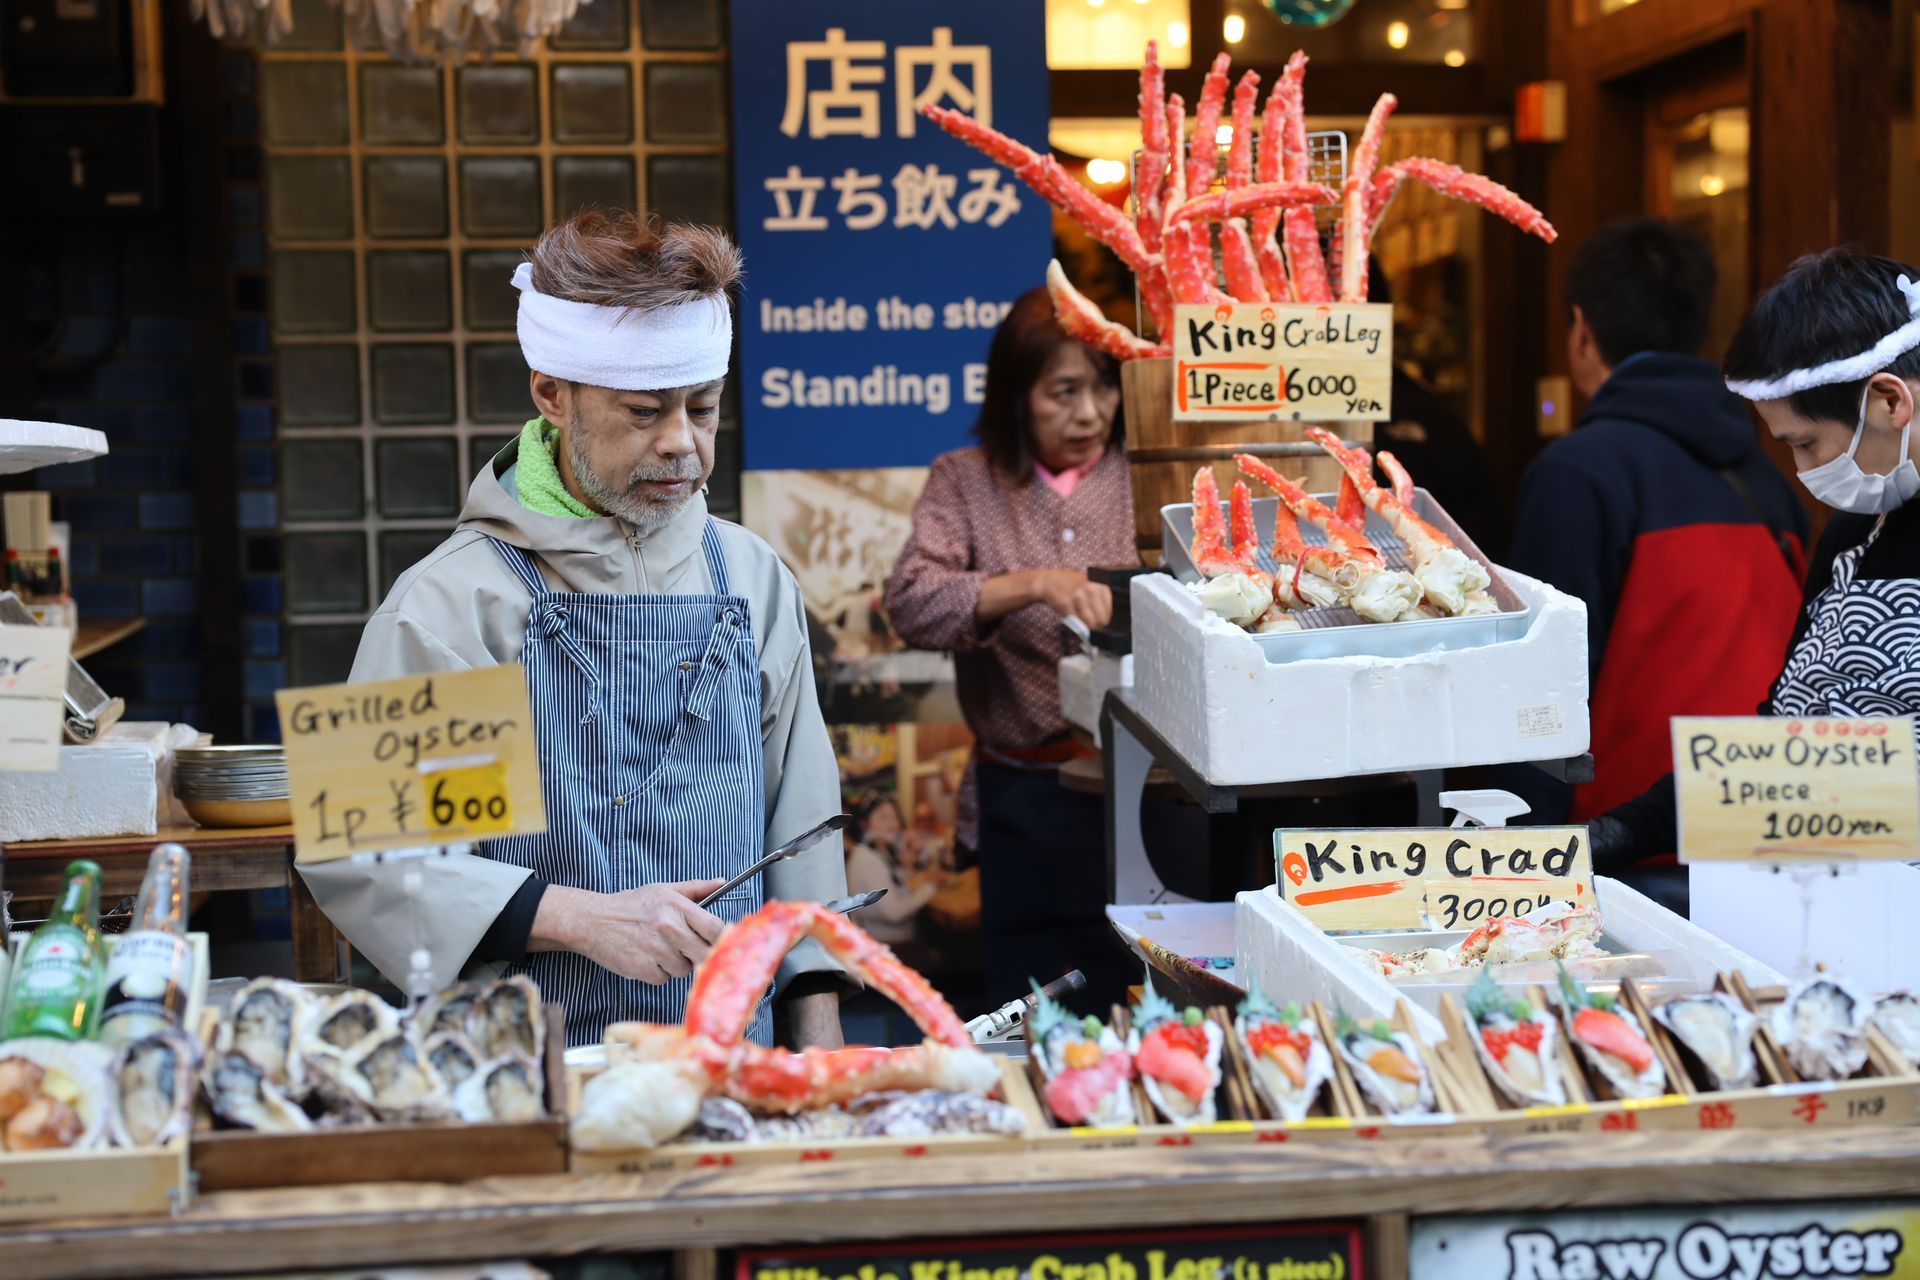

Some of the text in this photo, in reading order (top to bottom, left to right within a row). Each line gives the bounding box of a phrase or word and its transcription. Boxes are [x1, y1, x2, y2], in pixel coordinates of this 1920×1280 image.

[780, 27, 992, 138] 店内
[763, 163, 1021, 230] 立ち飲み
[760, 299, 867, 332] Inside
[876, 297, 935, 330] the
[1188, 317, 1276, 356] King
[761, 363, 950, 414] Standing
[1285, 367, 1357, 402] 6000
[1345, 397, 1383, 414] yen
[290, 678, 437, 734] Grilled
[374, 718, 518, 767] Oyster
[1689, 734, 1902, 771] Raw Oyster
[1305, 834, 1579, 882] King Crad
[1508, 1221, 1903, 1280] Raw Oyster
